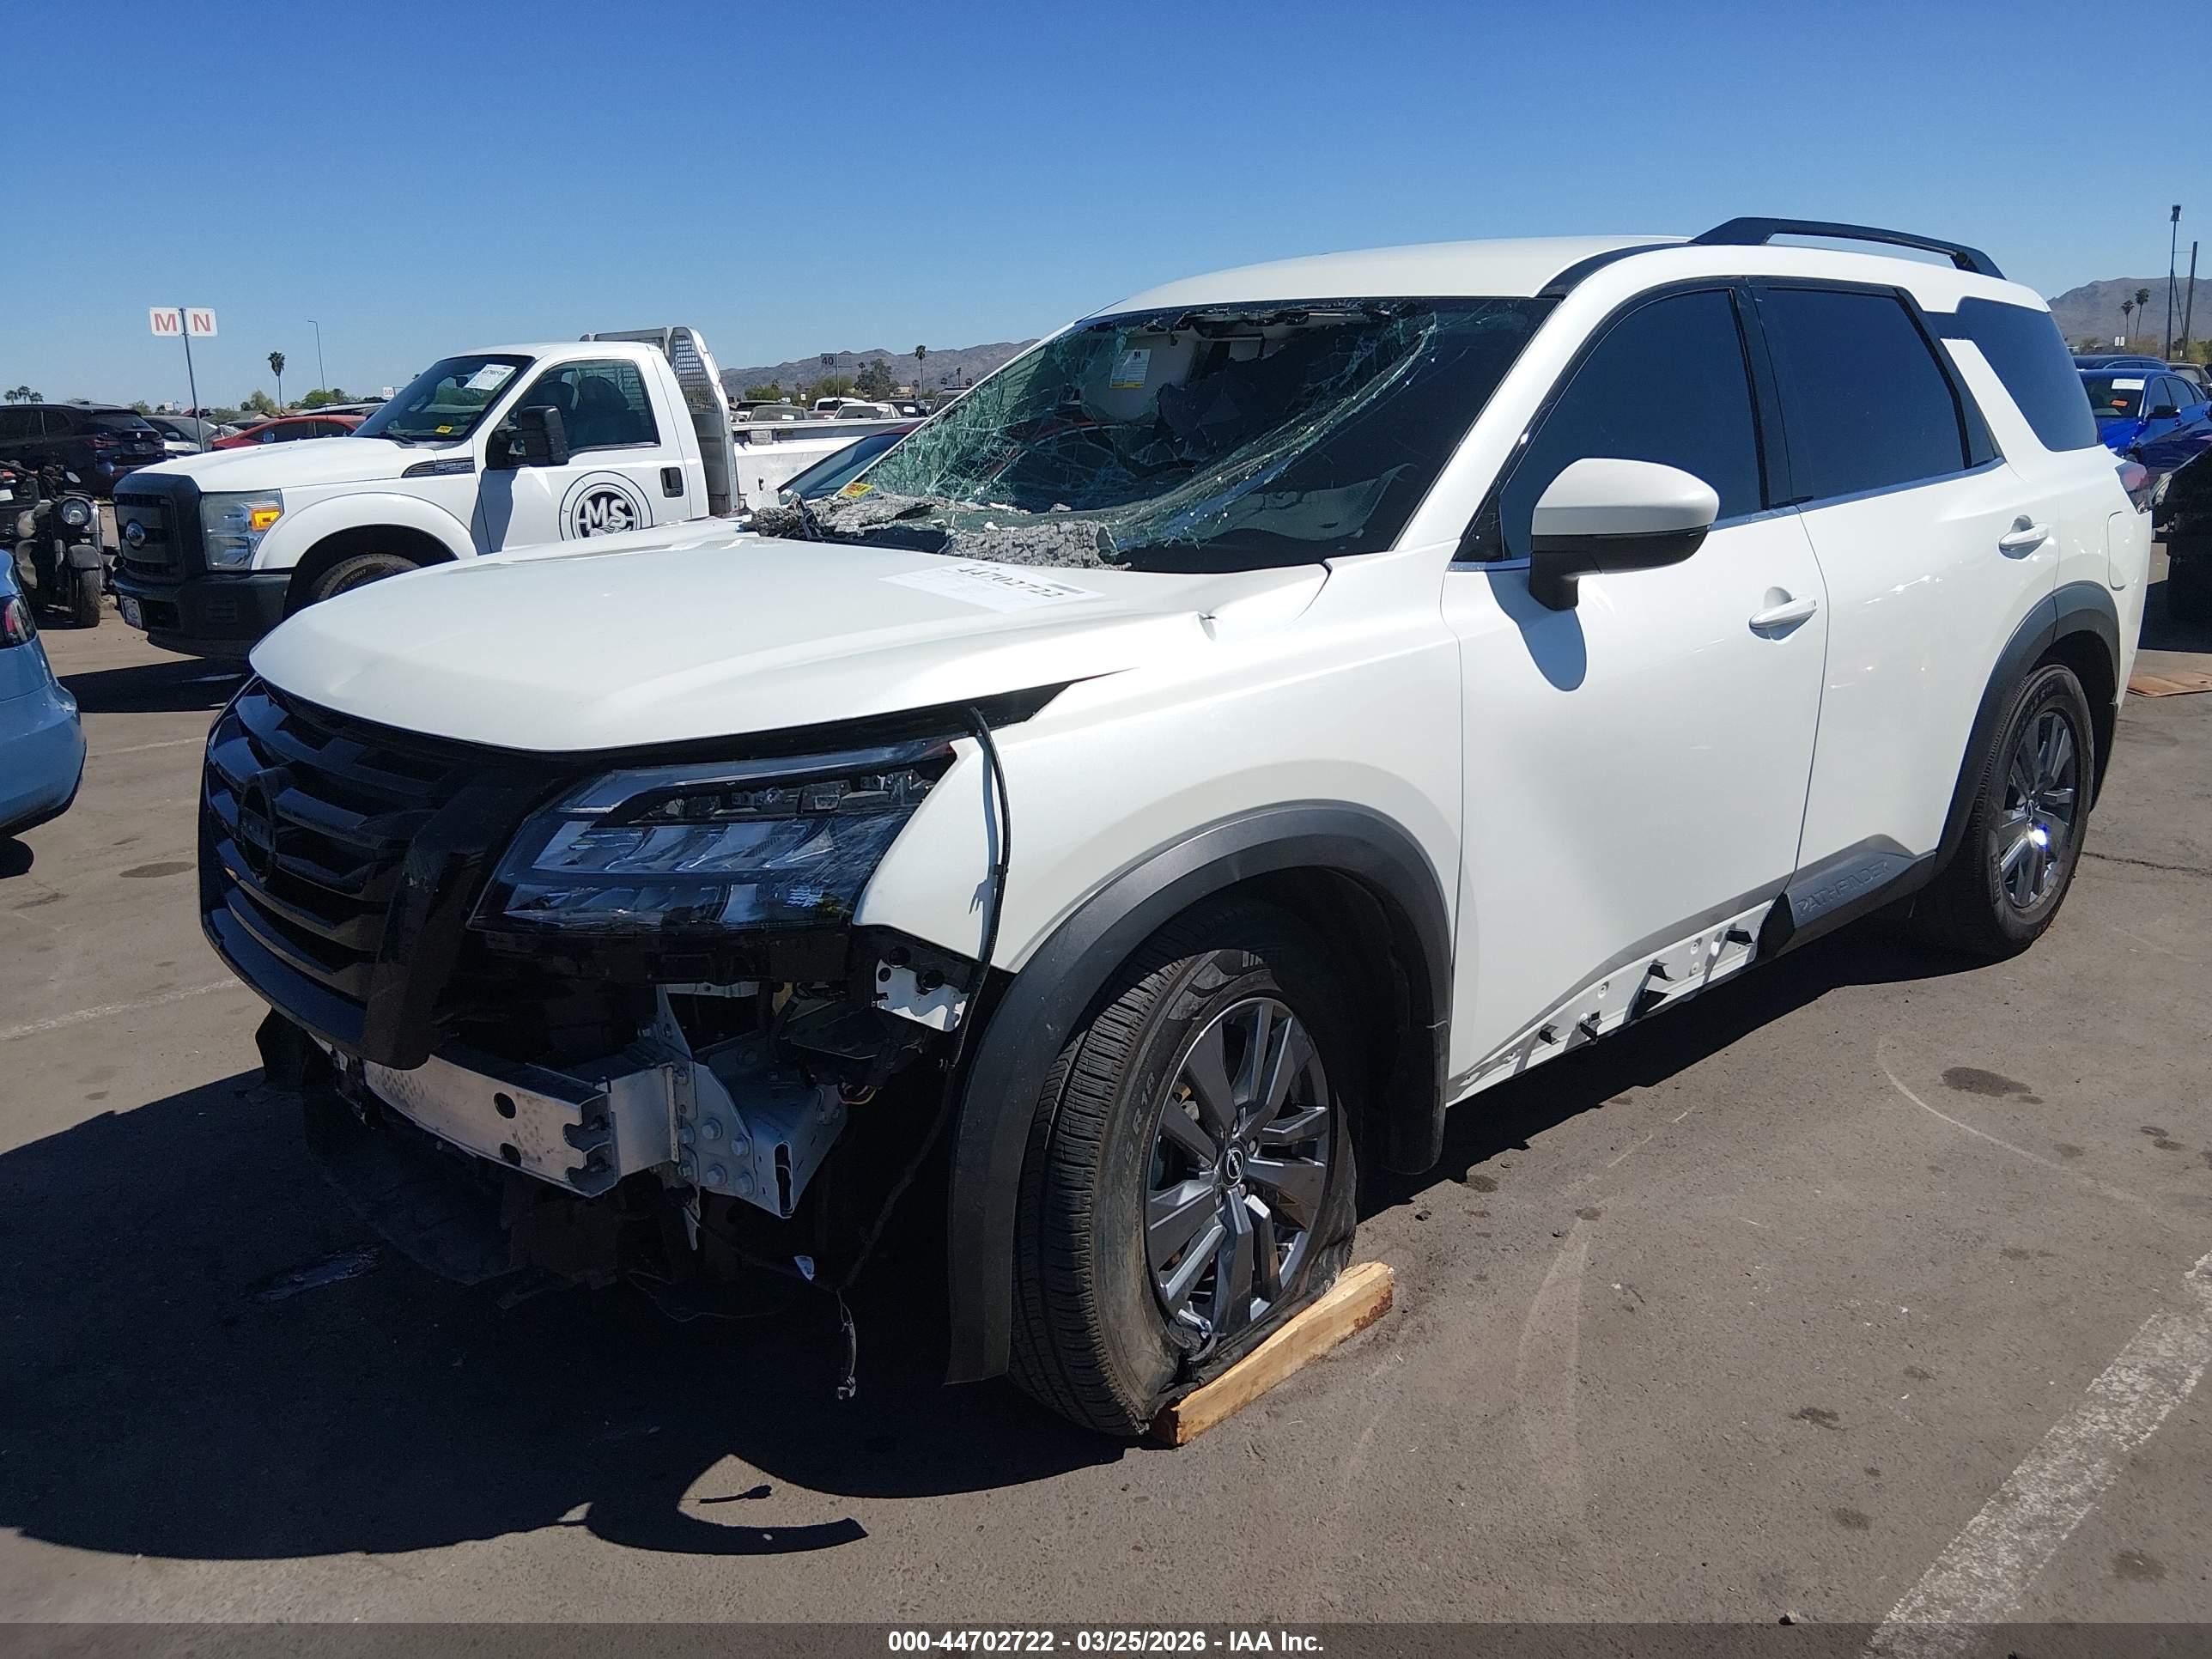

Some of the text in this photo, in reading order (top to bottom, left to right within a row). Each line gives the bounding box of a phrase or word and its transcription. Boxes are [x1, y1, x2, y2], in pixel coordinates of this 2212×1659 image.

[155, 313, 178, 331] M
[192, 313, 212, 332] N
[822, 356, 834, 366] 40
[1794, 858, 1890, 916] PATHFINDER
